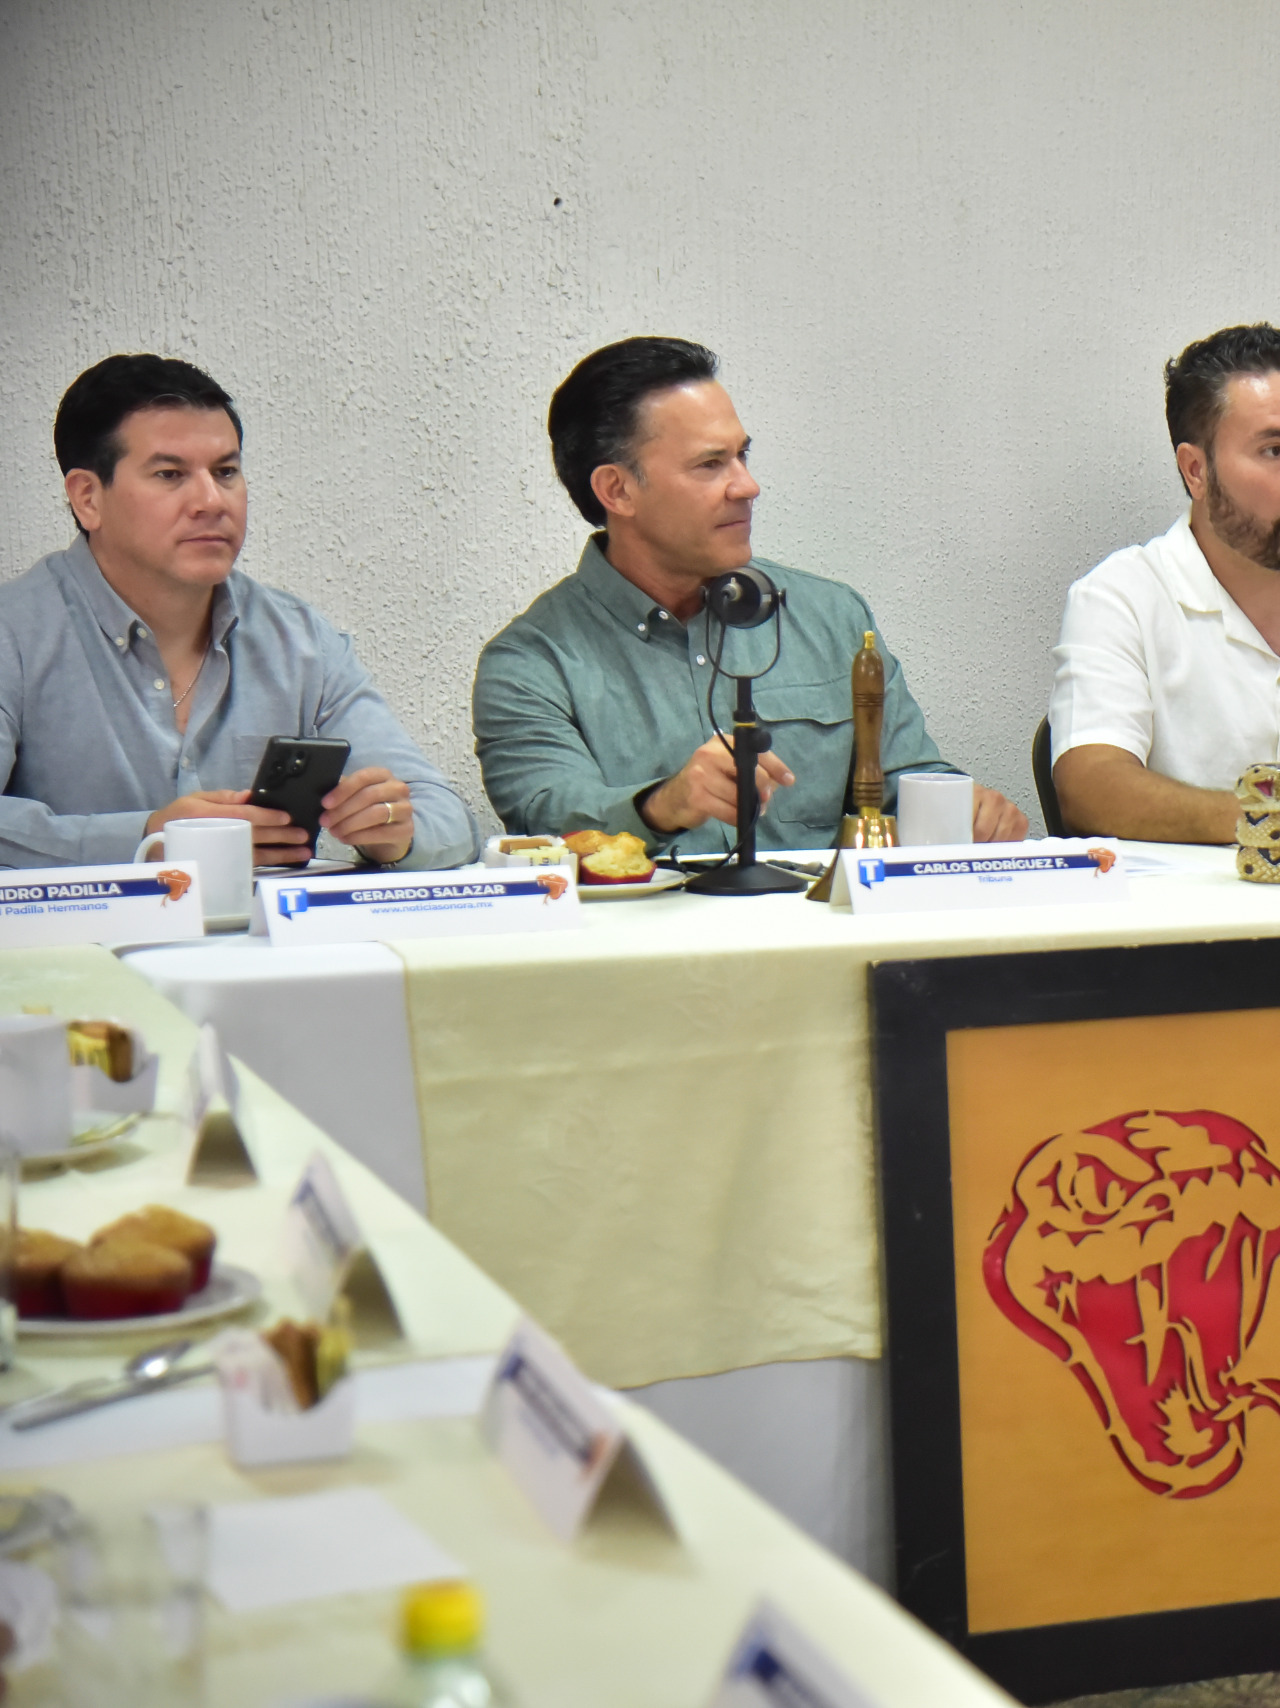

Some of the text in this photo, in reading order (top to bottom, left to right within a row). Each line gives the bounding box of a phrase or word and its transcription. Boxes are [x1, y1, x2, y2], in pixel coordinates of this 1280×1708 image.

[913, 857, 1069, 875] CARLOS RODRÍGUEZ F.
[978, 874, 1013, 883] Tribuna
[47, 882, 122, 899] PADILLA
[351, 884, 506, 903] GERARDO SALAZAR
[5, 904, 44, 916] Padilla
[48, 902, 109, 913] Hermanos
